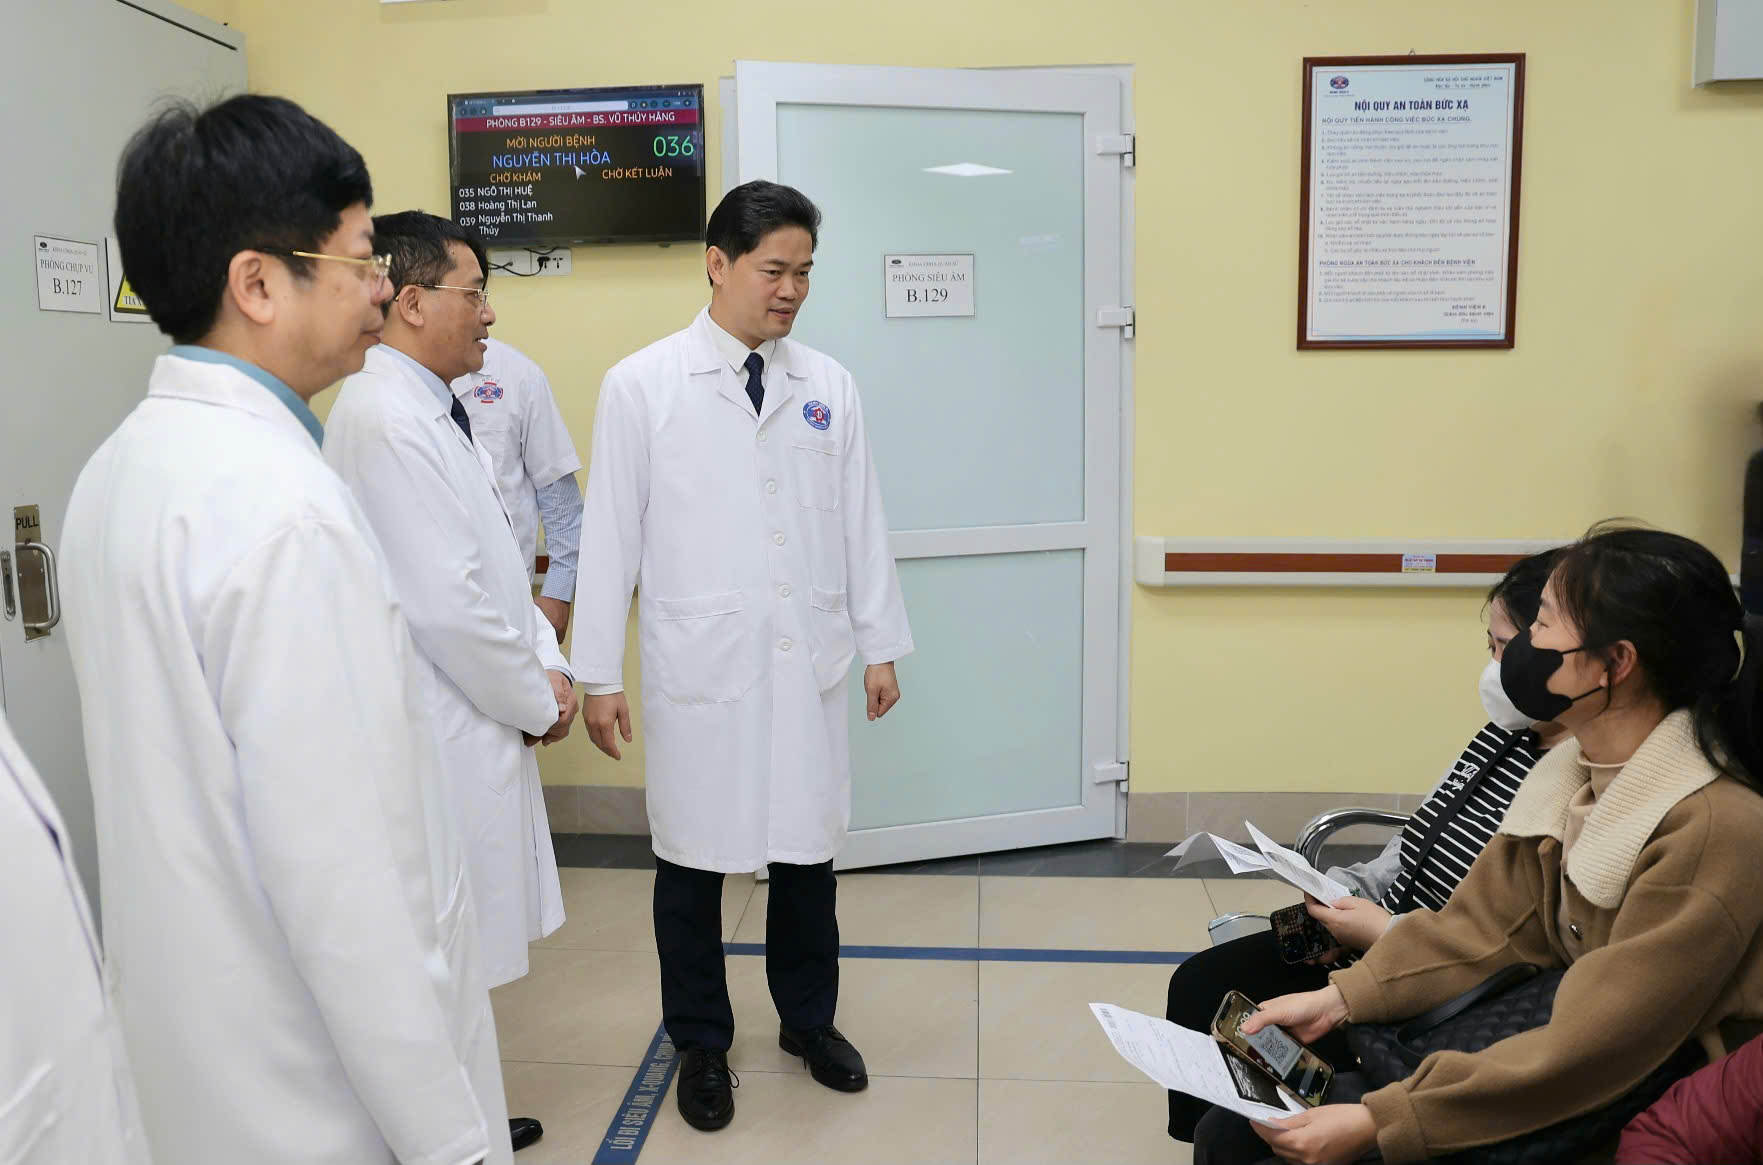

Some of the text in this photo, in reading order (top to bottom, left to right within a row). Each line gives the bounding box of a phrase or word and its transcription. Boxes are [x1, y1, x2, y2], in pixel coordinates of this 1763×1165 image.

[1354, 98, 1469, 113] NỘI QUY AN TOÀN BỨC XẠ
[486, 118, 518, 129] PHÒNG
[519, 117, 541, 127] B129
[549, 114, 568, 126] SIÊU
[571, 114, 585, 125] ÂM
[593, 115, 606, 124] BS.
[506, 133, 595, 149] MỜI NGƯỜI BỆNH
[653, 135, 694, 157] 036
[492, 150, 550, 168] NGUYỄN
[580, 148, 611, 165] HÒA
[490, 171, 541, 183] CHỜ KHÁM
[602, 165, 673, 180] CHỜ KẾT LUẬN
[459, 184, 534, 198] 035 NGÔ THỊ HUỆ
[460, 199, 537, 211] 038 Hoàng Thị Lan
[460, 211, 553, 227] 039 Nguyễn Thị Thanh
[40, 257, 65, 271] PHÒNG
[893, 271, 965, 282] PHÒNG SIÊU ÂM
[53, 277, 82, 296] B.127
[907, 288, 948, 303] B.129
[16, 515, 38, 529] PULL
[605, 1137, 636, 1150] LỐI
[621, 1108, 649, 1125] SIÊU
